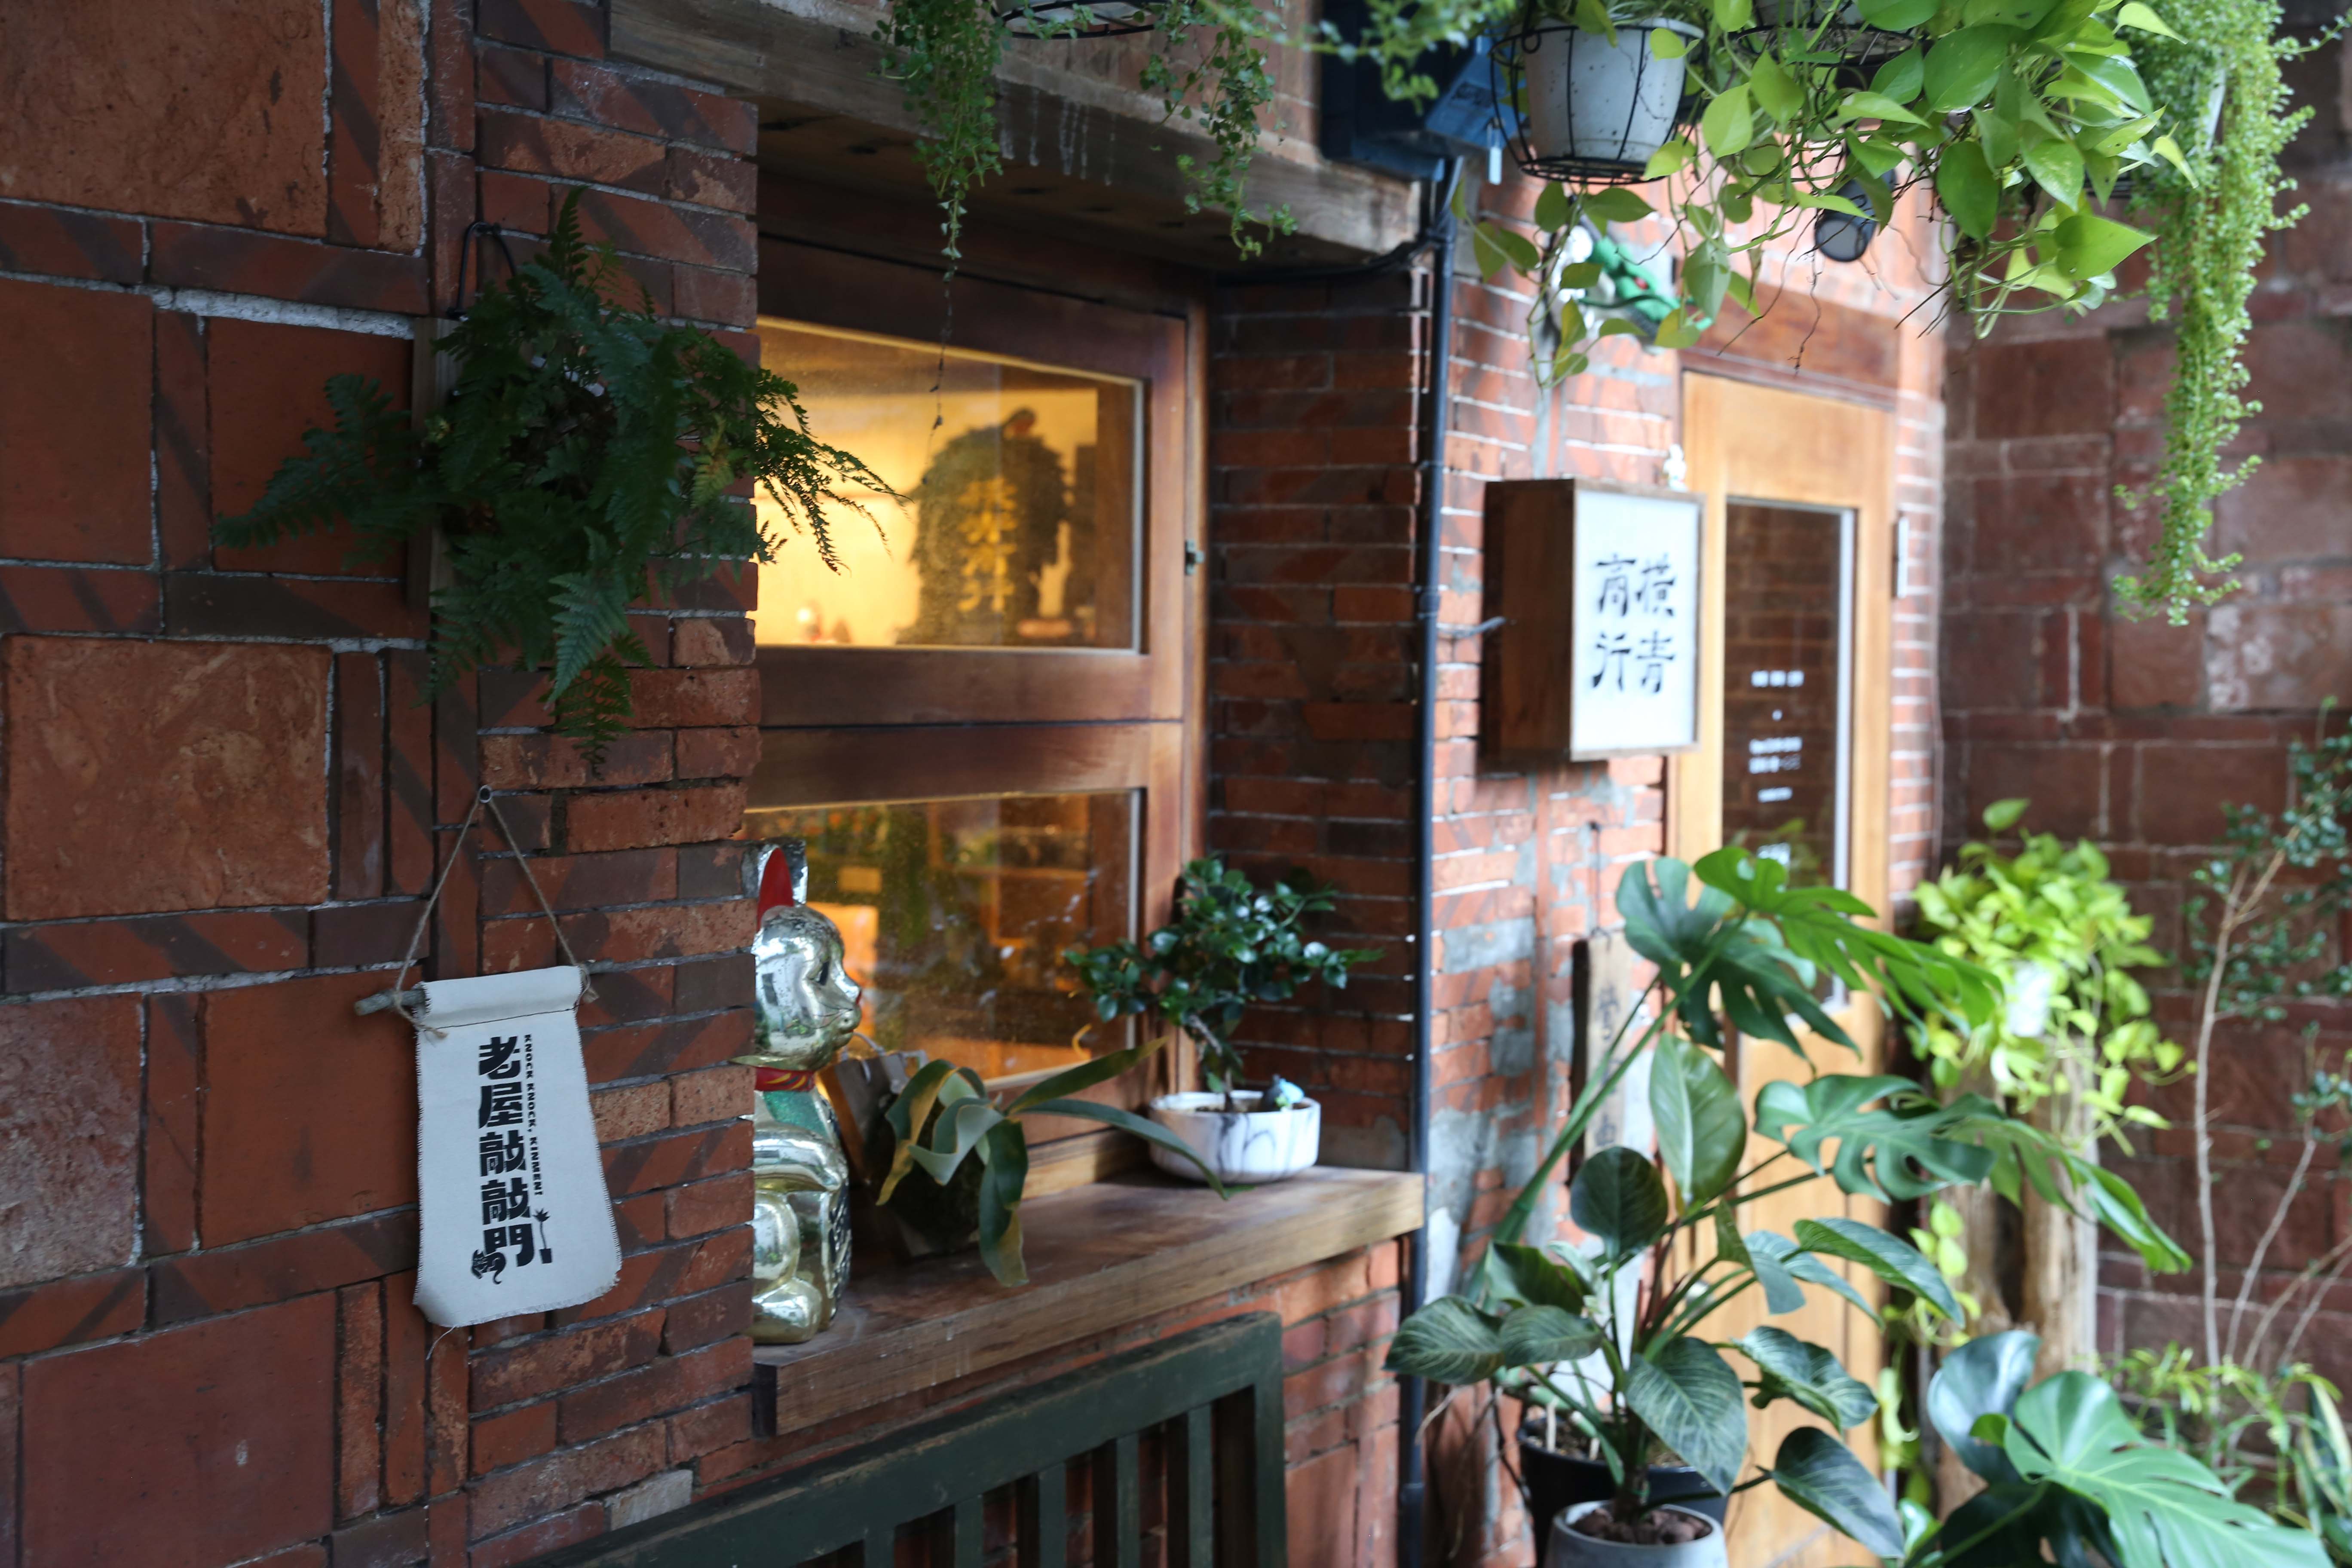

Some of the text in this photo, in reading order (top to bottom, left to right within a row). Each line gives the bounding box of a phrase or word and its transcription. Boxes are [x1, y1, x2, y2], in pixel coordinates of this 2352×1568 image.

[478, 1035, 535, 1271] 老屋敲敲門
[524, 1034, 543, 1196] KNOCK KNOCK, KINMEN!
